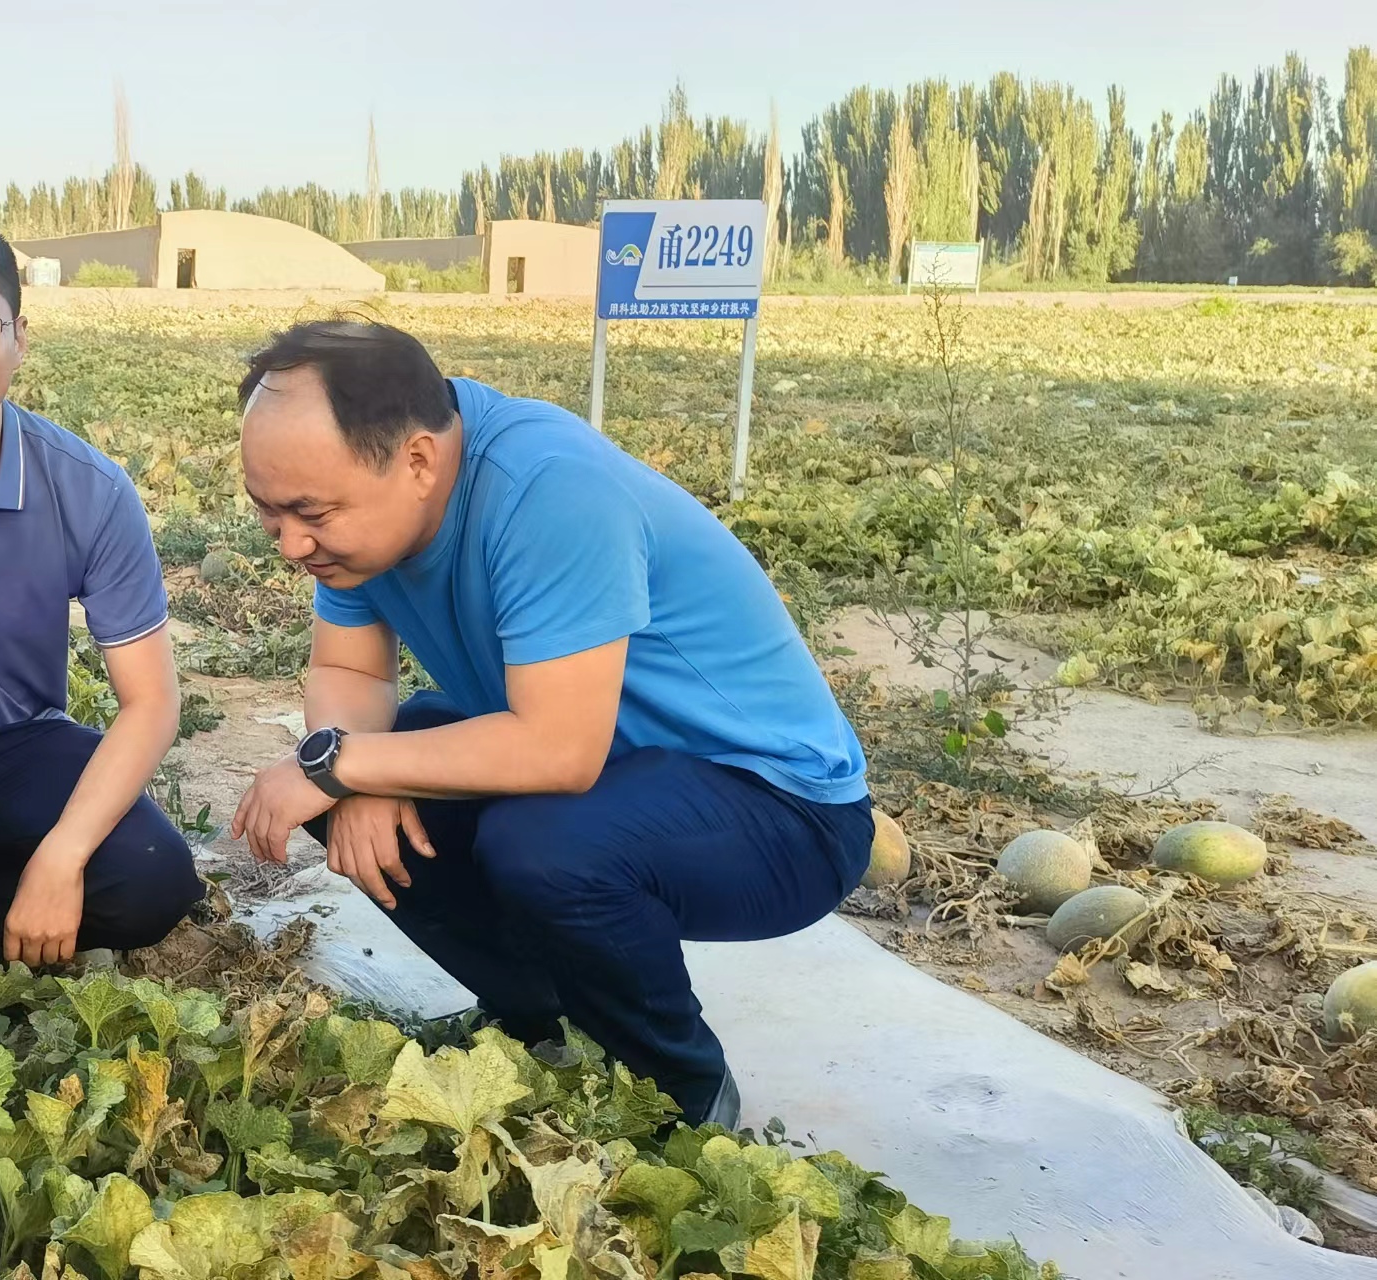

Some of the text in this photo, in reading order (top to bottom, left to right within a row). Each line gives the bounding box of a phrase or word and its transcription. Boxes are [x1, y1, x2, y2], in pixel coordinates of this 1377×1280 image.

[658, 223, 754, 270] 甬2249
[608, 302, 750, 316] 用科技助力脱贫攻坚和乡村振兴
